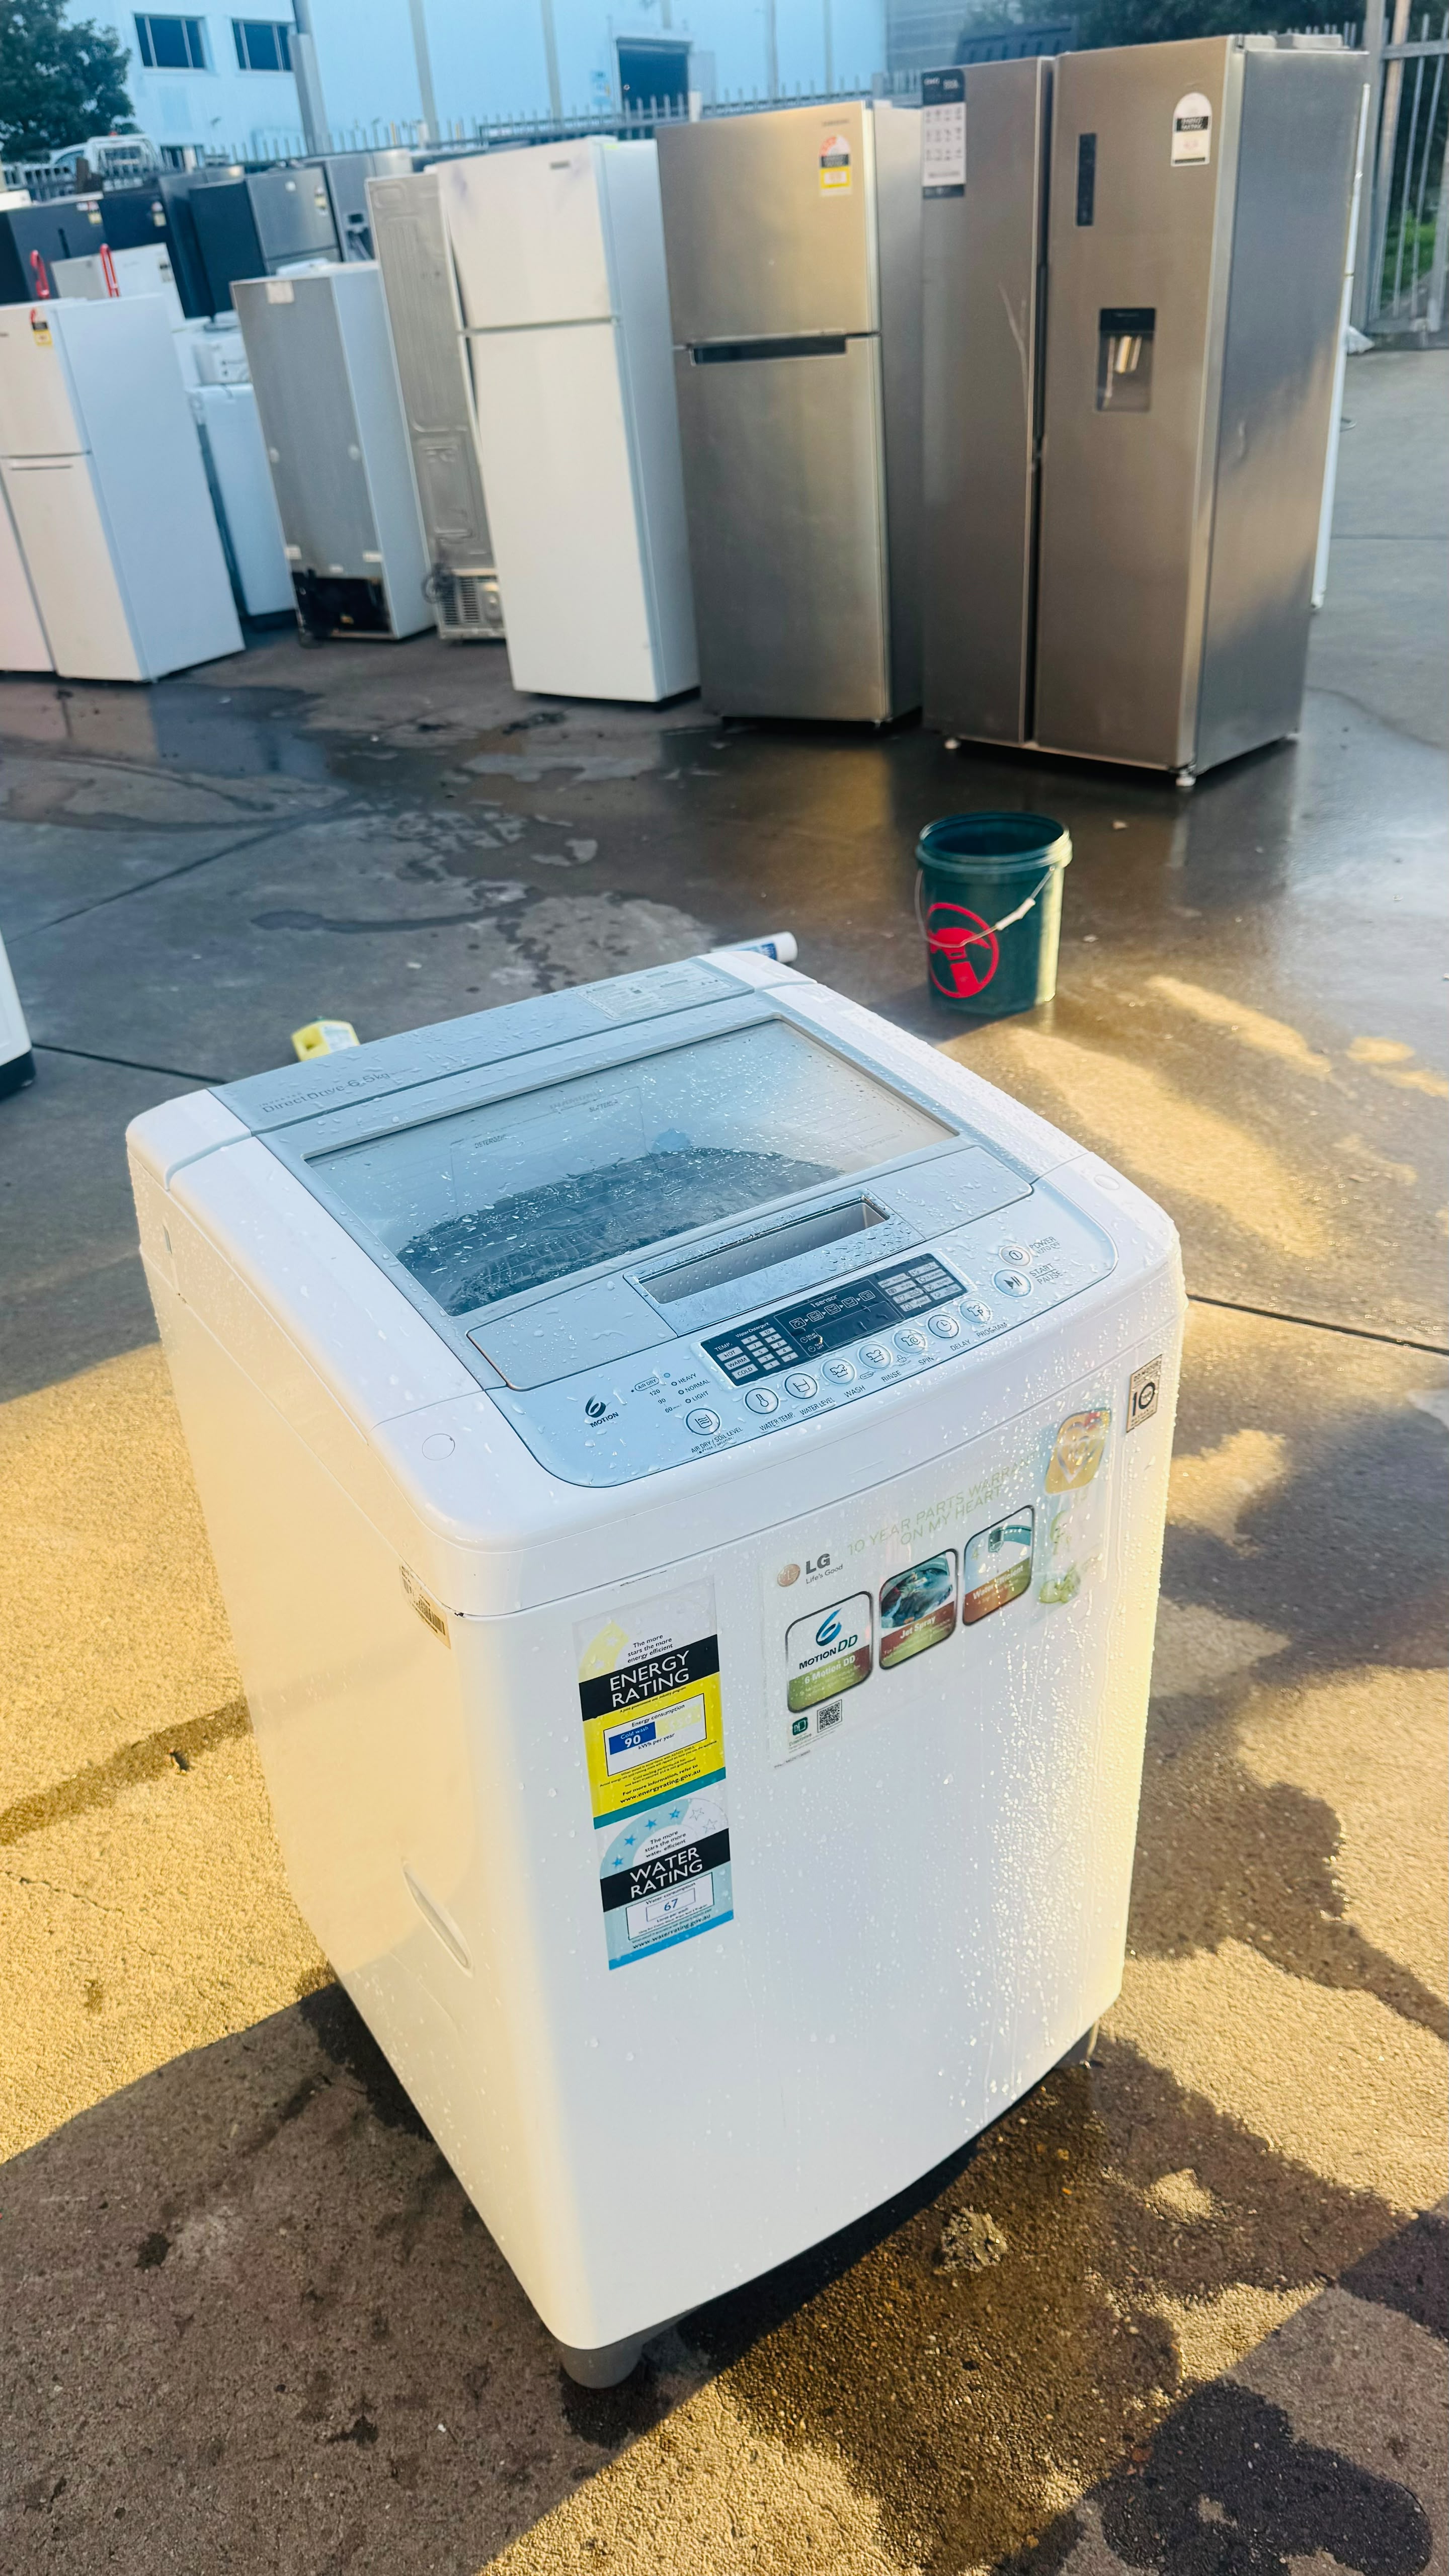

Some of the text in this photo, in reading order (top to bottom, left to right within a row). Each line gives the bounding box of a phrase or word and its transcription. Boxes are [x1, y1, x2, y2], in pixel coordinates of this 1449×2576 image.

[1029, 1263, 1054, 1277] START
[1037, 1270, 1063, 1284] PAUSE
[977, 1322, 1008, 1338] PROGRAM
[950, 1339, 971, 1351] DELAY
[728, 1358, 747, 1369] WARM
[918, 1356, 934, 1366] SPIN
[679, 1373, 697, 1384] HEAVY
[738, 1366, 753, 1377] COLD
[881, 1370, 902, 1382] RINSE
[685, 1379, 710, 1393] NORMAL
[844, 1386, 866, 1398] WASH
[691, 1391, 709, 1402] LIGHT
[799, 1397, 835, 1415] WATER LEVEL
[590, 1412, 619, 1428] MOTION
[759, 1412, 796, 1431] WATER TEMP.
[691, 1445, 700, 1454] AIR
[700, 1440, 711, 1450] DRY
[714, 1434, 726, 1443] SOIL
[726, 1427, 743, 1437] LEVEL
[869, 1518, 910, 1545] YEAR
[917, 1492, 964, 1525] PARTS
[901, 1484, 1003, 1545] ON MY HEART
[806, 1553, 830, 1575] LG
[806, 1563, 843, 1584] Life's Good
[900, 1616, 936, 1639] Jet Spray
[628, 1649, 642, 1657] stars
[656, 1638, 672, 1647] more
[647, 1635, 663, 1643] more
[627, 1644, 673, 1663] energy efficient
[799, 1647, 836, 1670] MOTION
[838, 1634, 858, 1653] DD
[609, 1651, 690, 1692] ENERGY
[804, 1655, 855, 1684] 6 Motion DD
[612, 1668, 690, 1707] RATING
[632, 1705, 685, 1727] Energy consumption
[620, 1731, 634, 1739] Cold
[624, 1734, 641, 1748] 90
[638, 1742, 652, 1750] kWh
[664, 1733, 675, 1741] year
[620, 1769, 701, 1804] www.energyrating.gov.au
[632, 1785, 647, 1793] more
[647, 1773, 679, 1787] information,
[679, 1766, 692, 1775] refer
[645, 1844, 658, 1853] stars
[671, 1833, 686, 1842] more
[663, 1831, 678, 1839] more
[664, 1839, 686, 1851] efficient
[630, 1846, 700, 1883] WATER
[631, 1859, 703, 1899] RATING
[646, 1883, 696, 1905] Water consumption
[664, 1898, 678, 1911] 67
[632, 1914, 711, 1949] www.waterrating.gov.au
